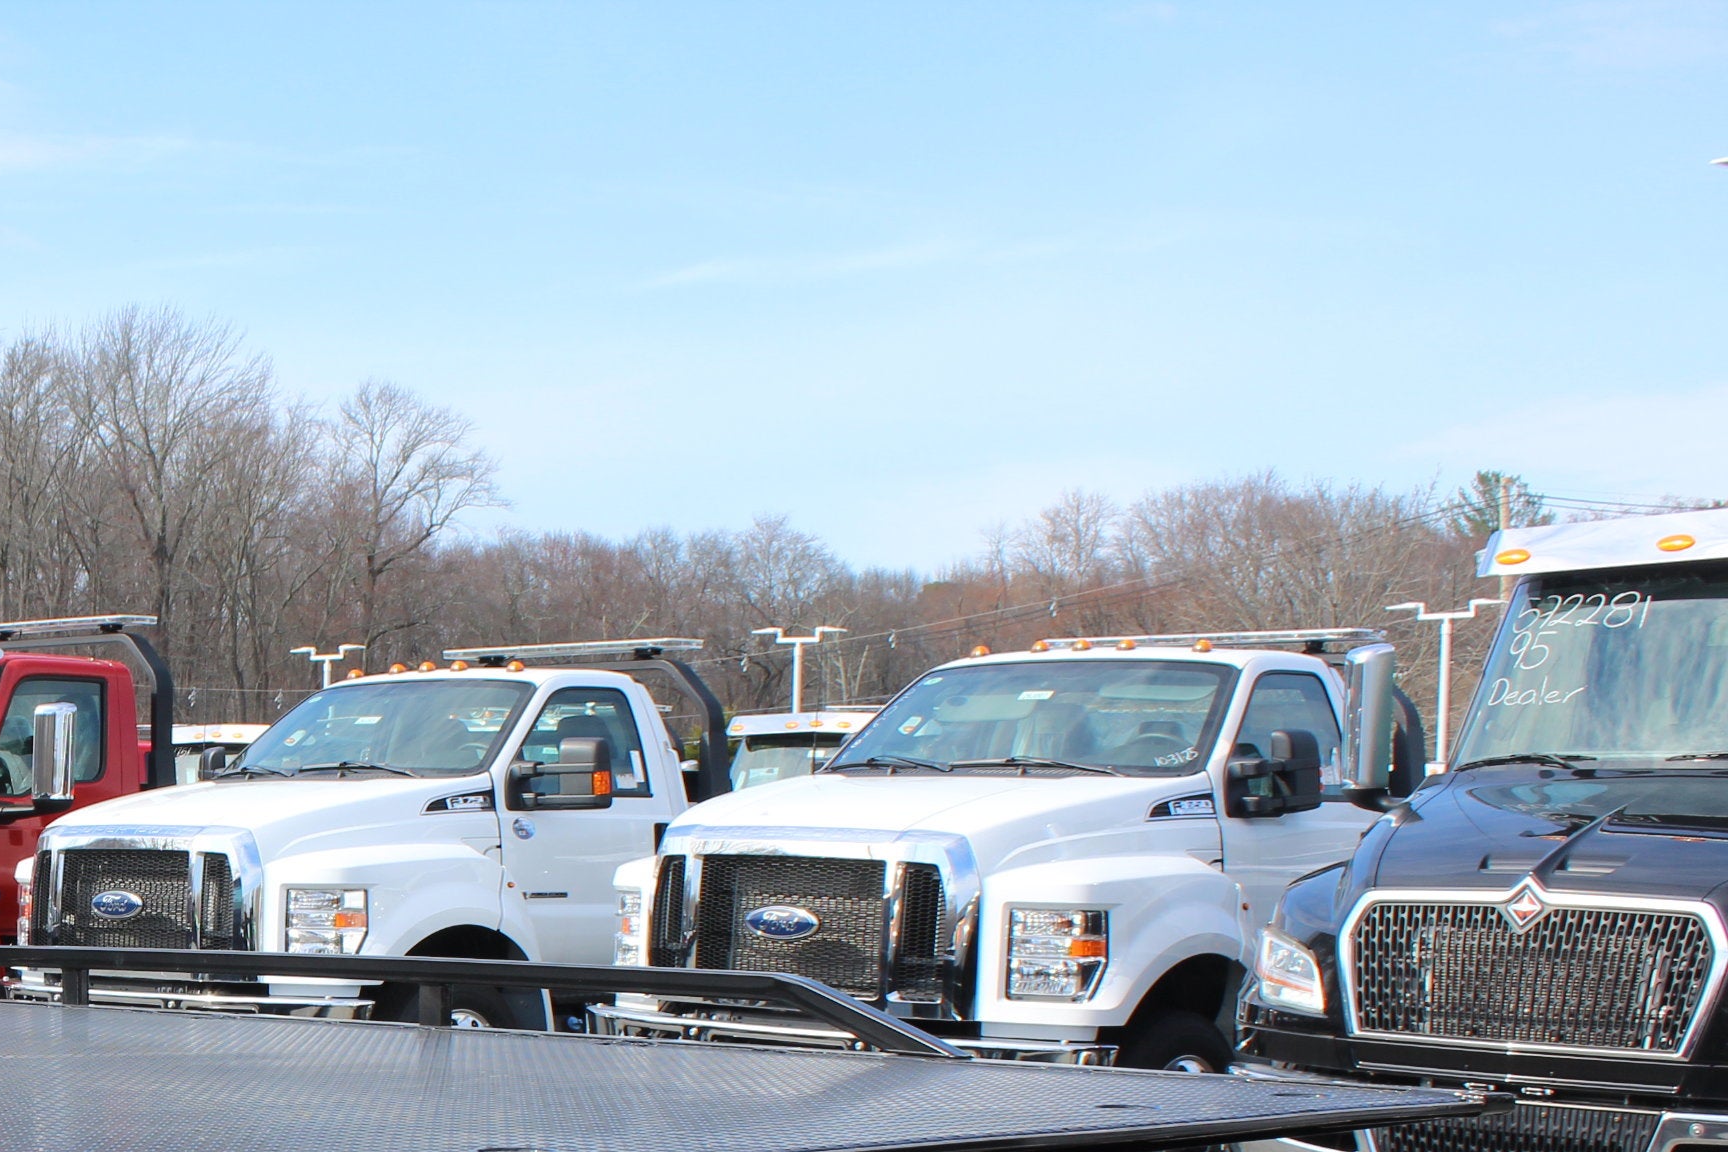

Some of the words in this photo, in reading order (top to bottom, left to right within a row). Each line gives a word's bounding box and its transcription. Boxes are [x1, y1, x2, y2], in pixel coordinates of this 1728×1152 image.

[1509, 630, 1558, 670] 95
[1486, 674, 1589, 707] Dealer
[100, 894, 129, 912] Ford
[758, 909, 801, 932] Ford
